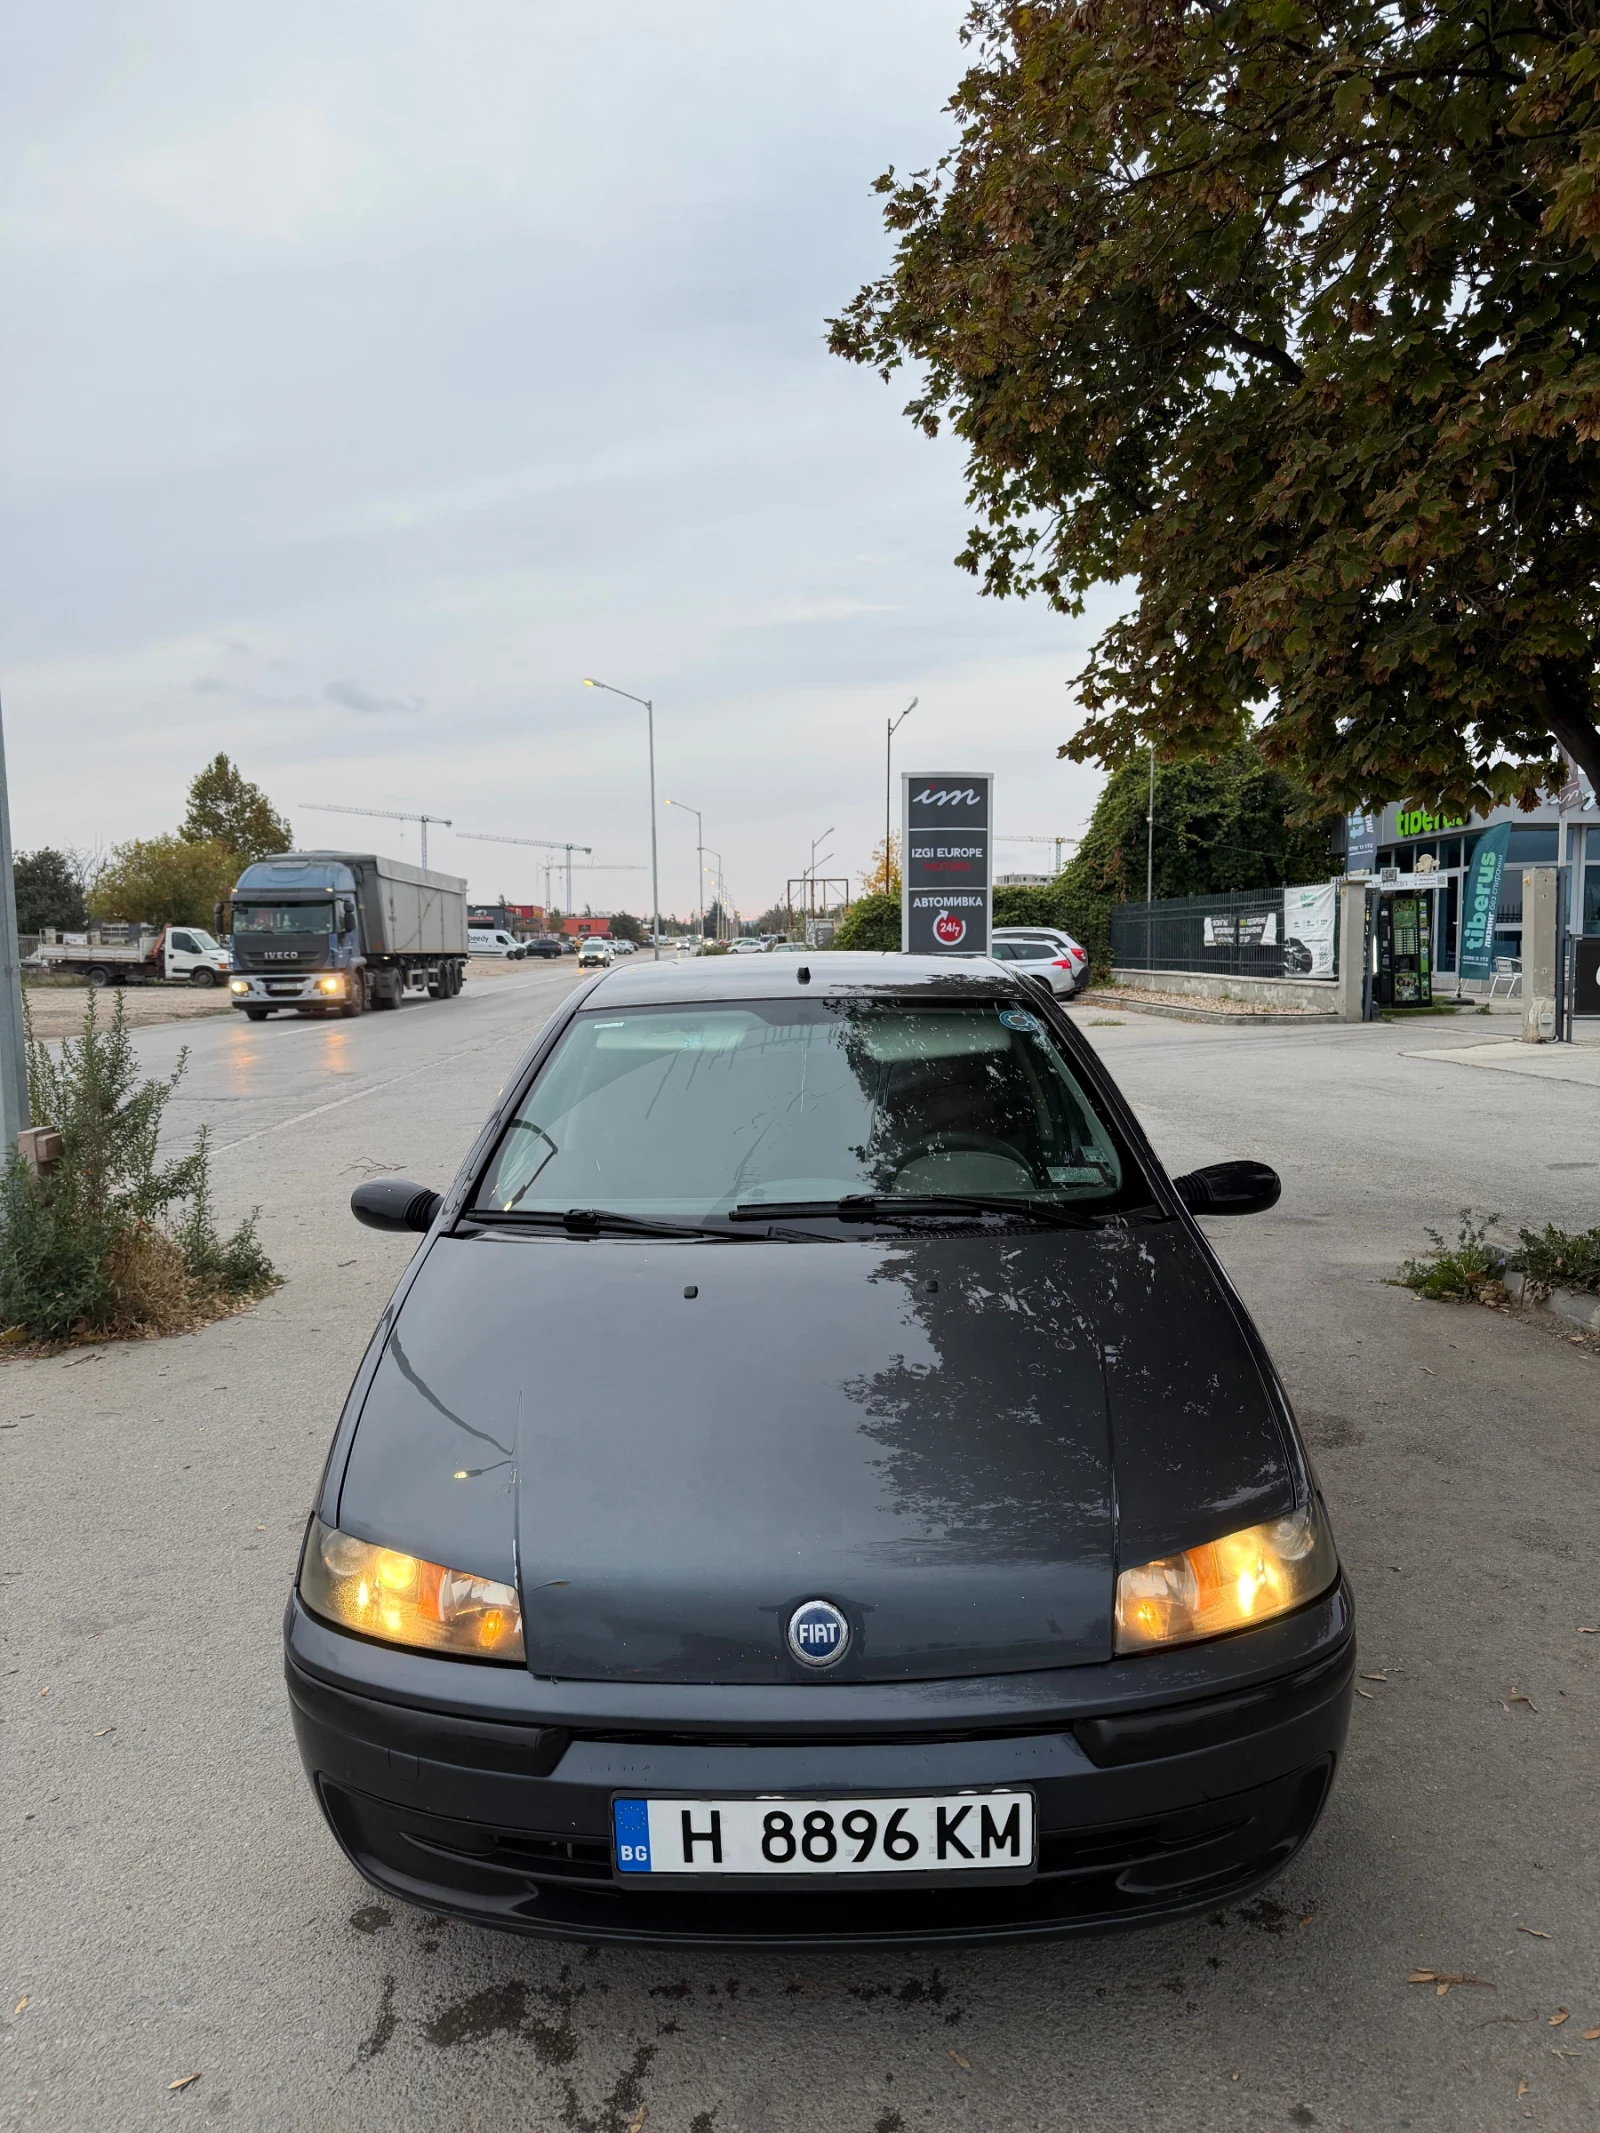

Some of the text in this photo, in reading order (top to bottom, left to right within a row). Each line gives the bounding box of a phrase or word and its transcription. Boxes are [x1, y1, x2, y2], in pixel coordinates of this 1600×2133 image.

[912, 848, 983, 858] IZGI EUROPE
[913, 896, 983, 908] АВТОМИВКА
[1464, 851, 1496, 950] tiberus
[940, 922, 960, 936] 24/7
[468, 934, 489, 943] peedy
[799, 1623, 837, 1644] FIAT
[681, 1803, 1020, 1863] H 8896 KM
[621, 1845, 647, 1861] BG
